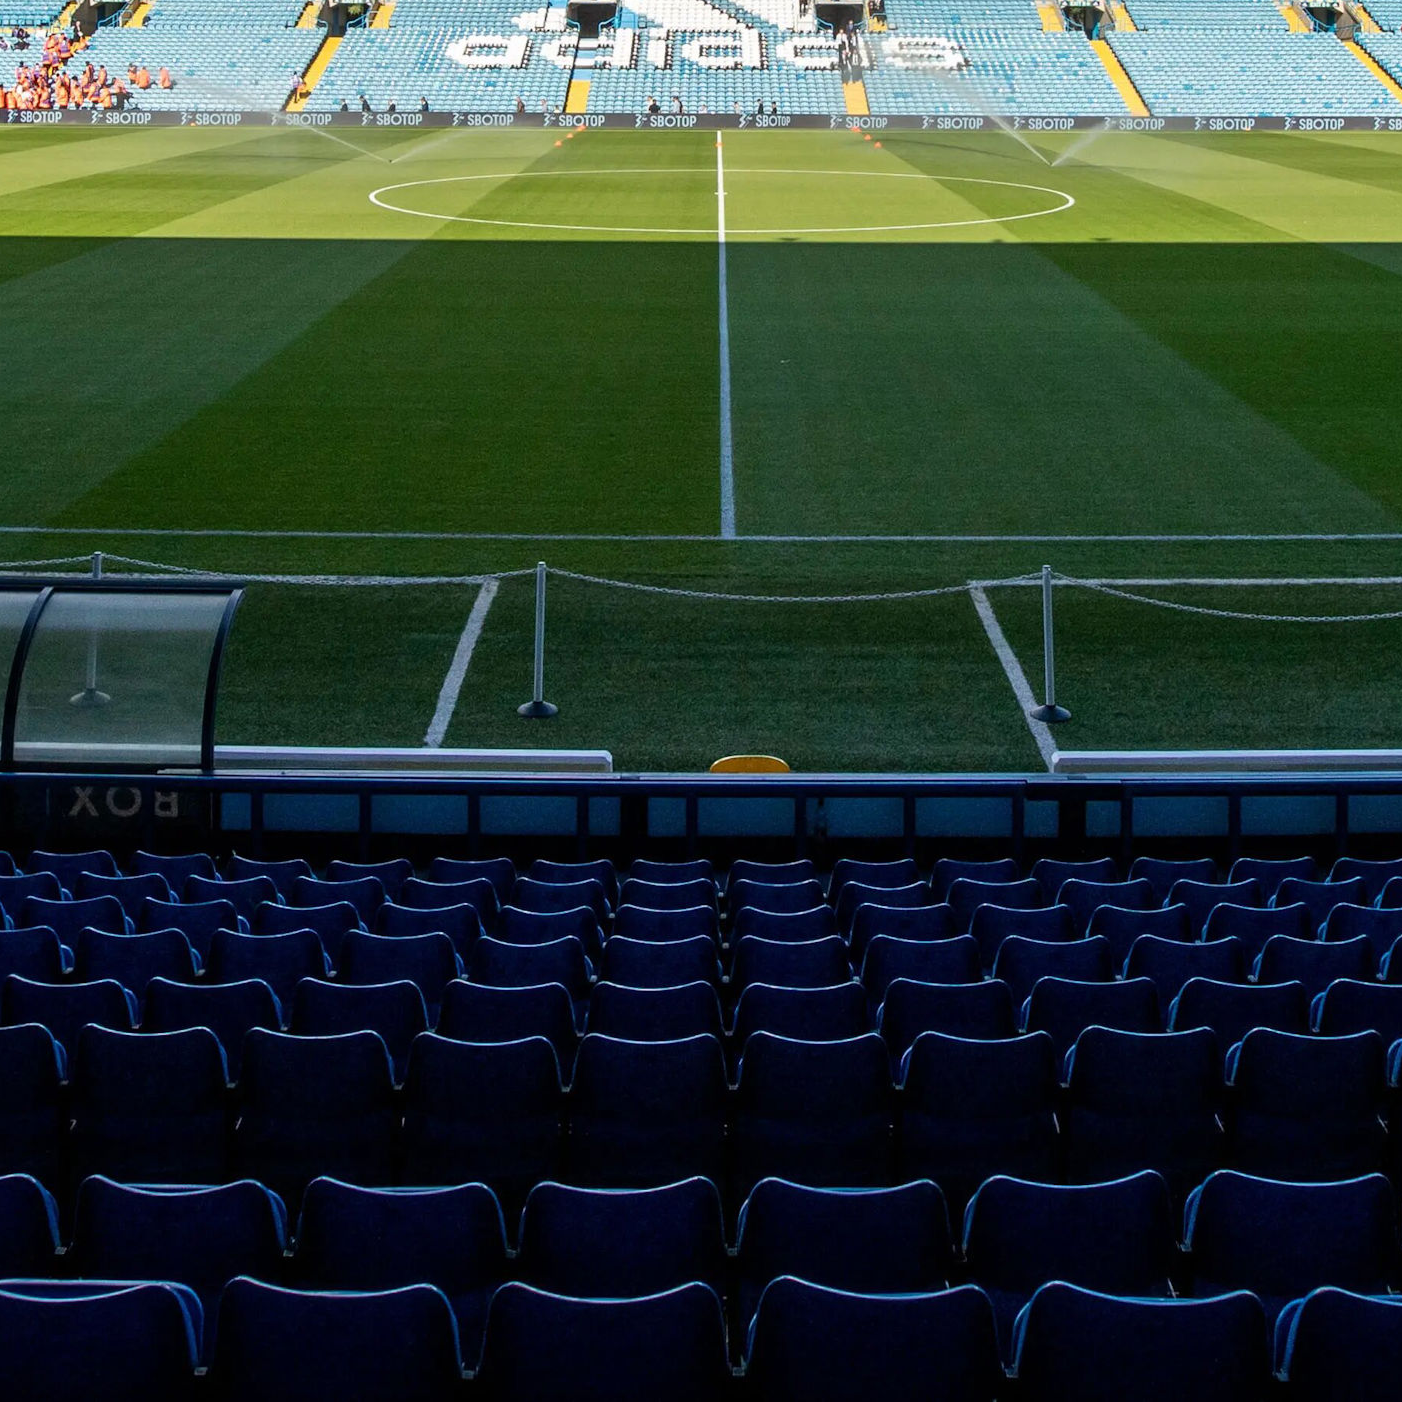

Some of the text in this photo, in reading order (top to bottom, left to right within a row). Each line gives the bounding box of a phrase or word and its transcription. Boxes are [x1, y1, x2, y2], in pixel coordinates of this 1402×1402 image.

[445, 27, 972, 72] adidas
[19, 109, 63, 123] SBOTOP
[106, 112, 152, 125] SBOTOP
[195, 113, 242, 125] SBOTOP
[285, 113, 332, 125] SBOTOP
[376, 113, 423, 125] SBOTOP
[467, 113, 514, 126] SBOTOP
[558, 114, 606, 127] SBOTOP
[650, 115, 697, 128] SBOTOP
[755, 115, 791, 127] SBOTOP
[841, 117, 888, 129] SBOTOP
[936, 118, 984, 130] SBOTOP
[1028, 118, 1075, 130] SBOTOP
[1118, 118, 1165, 130] SBOTOP
[1209, 118, 1255, 130] SBOTOP
[1298, 118, 1345, 131] SBOTOP
